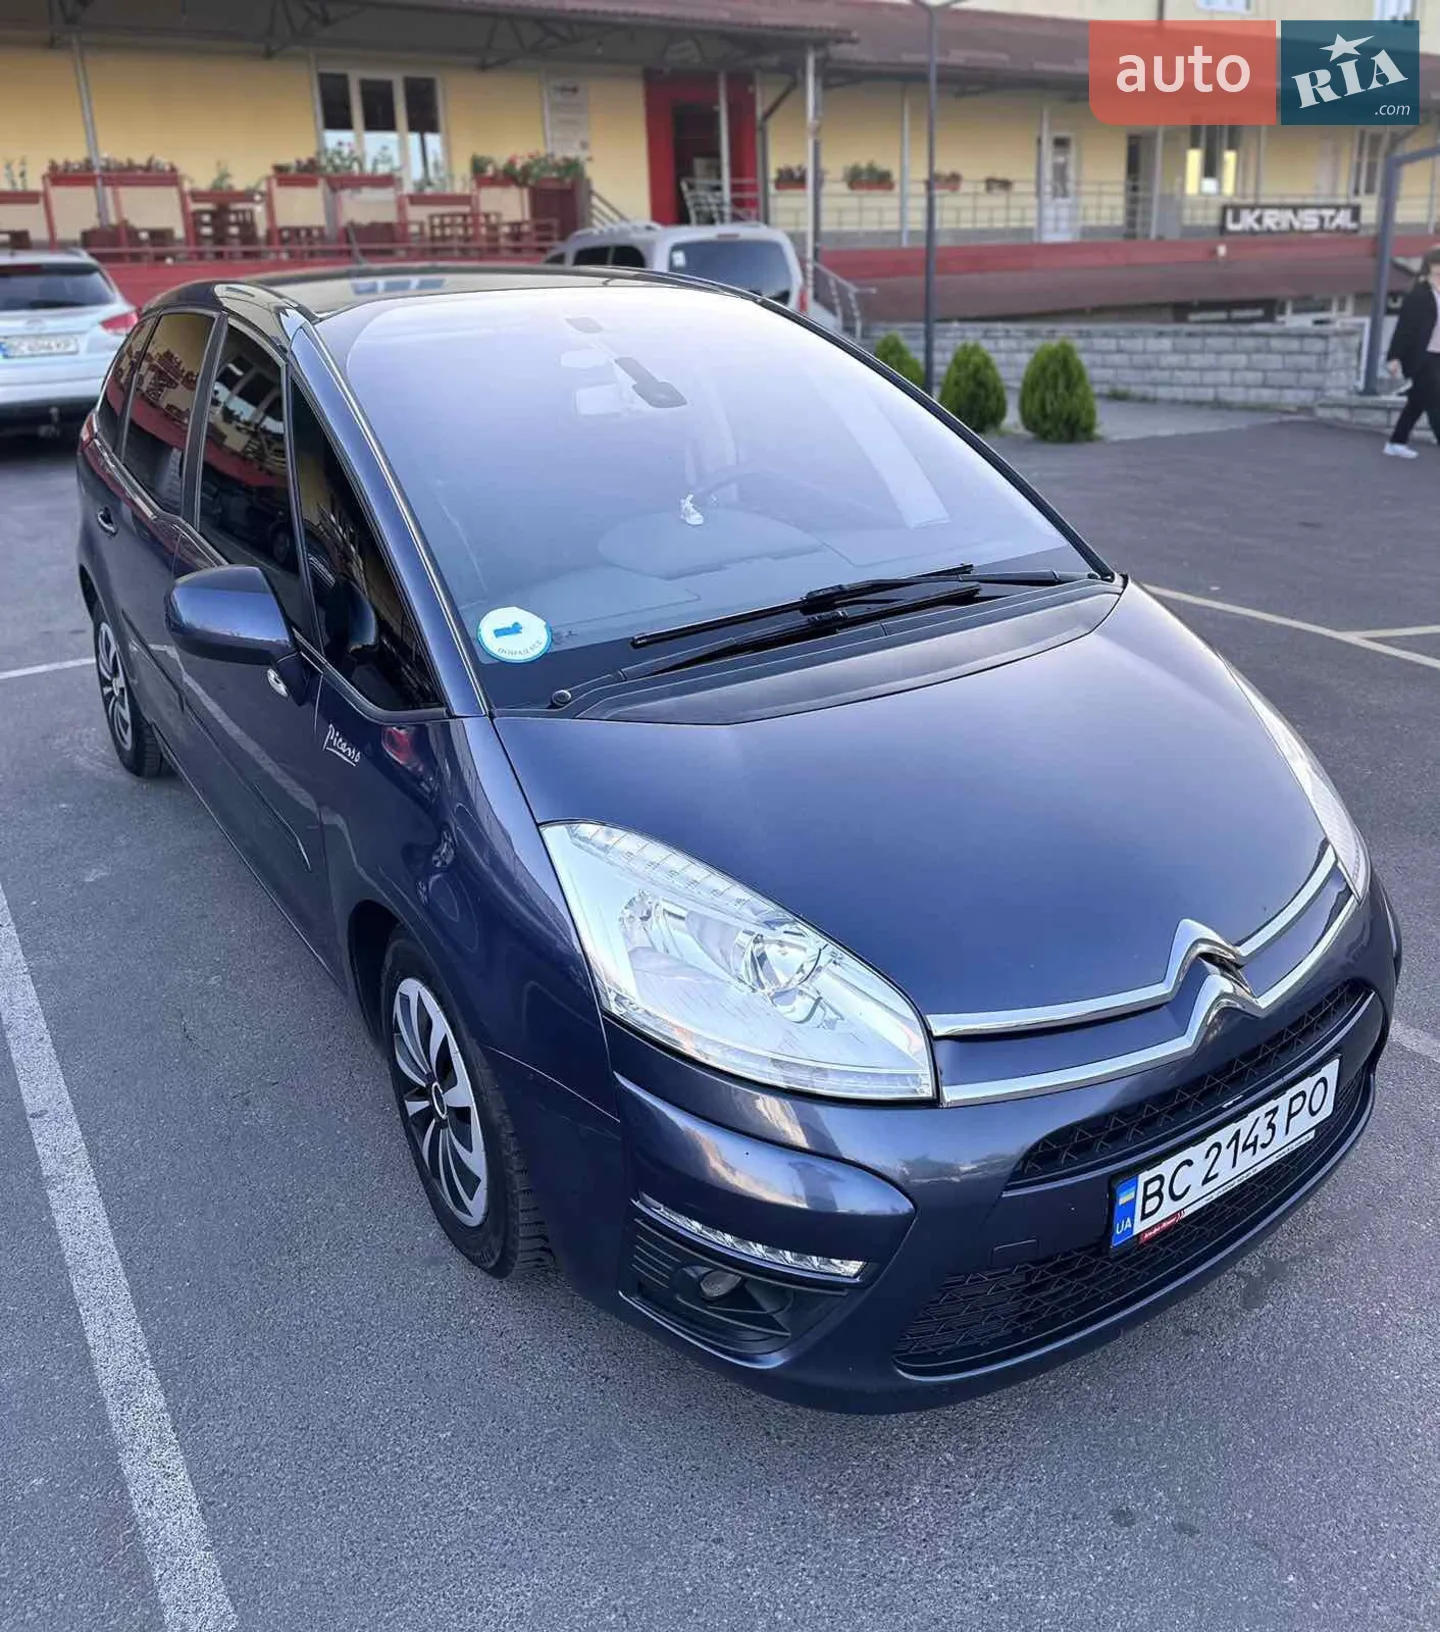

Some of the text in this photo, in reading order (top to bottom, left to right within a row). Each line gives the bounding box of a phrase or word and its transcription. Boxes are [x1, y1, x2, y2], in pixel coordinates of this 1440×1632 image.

[1225, 207, 1358, 232] UKRINSTAL
[322, 723, 361, 766] Picasso
[1140, 1158, 1194, 1222] BC
[1201, 1105, 1280, 1187] 2143
[1285, 1076, 1329, 1136] PO
[1116, 1217, 1132, 1235] UA
